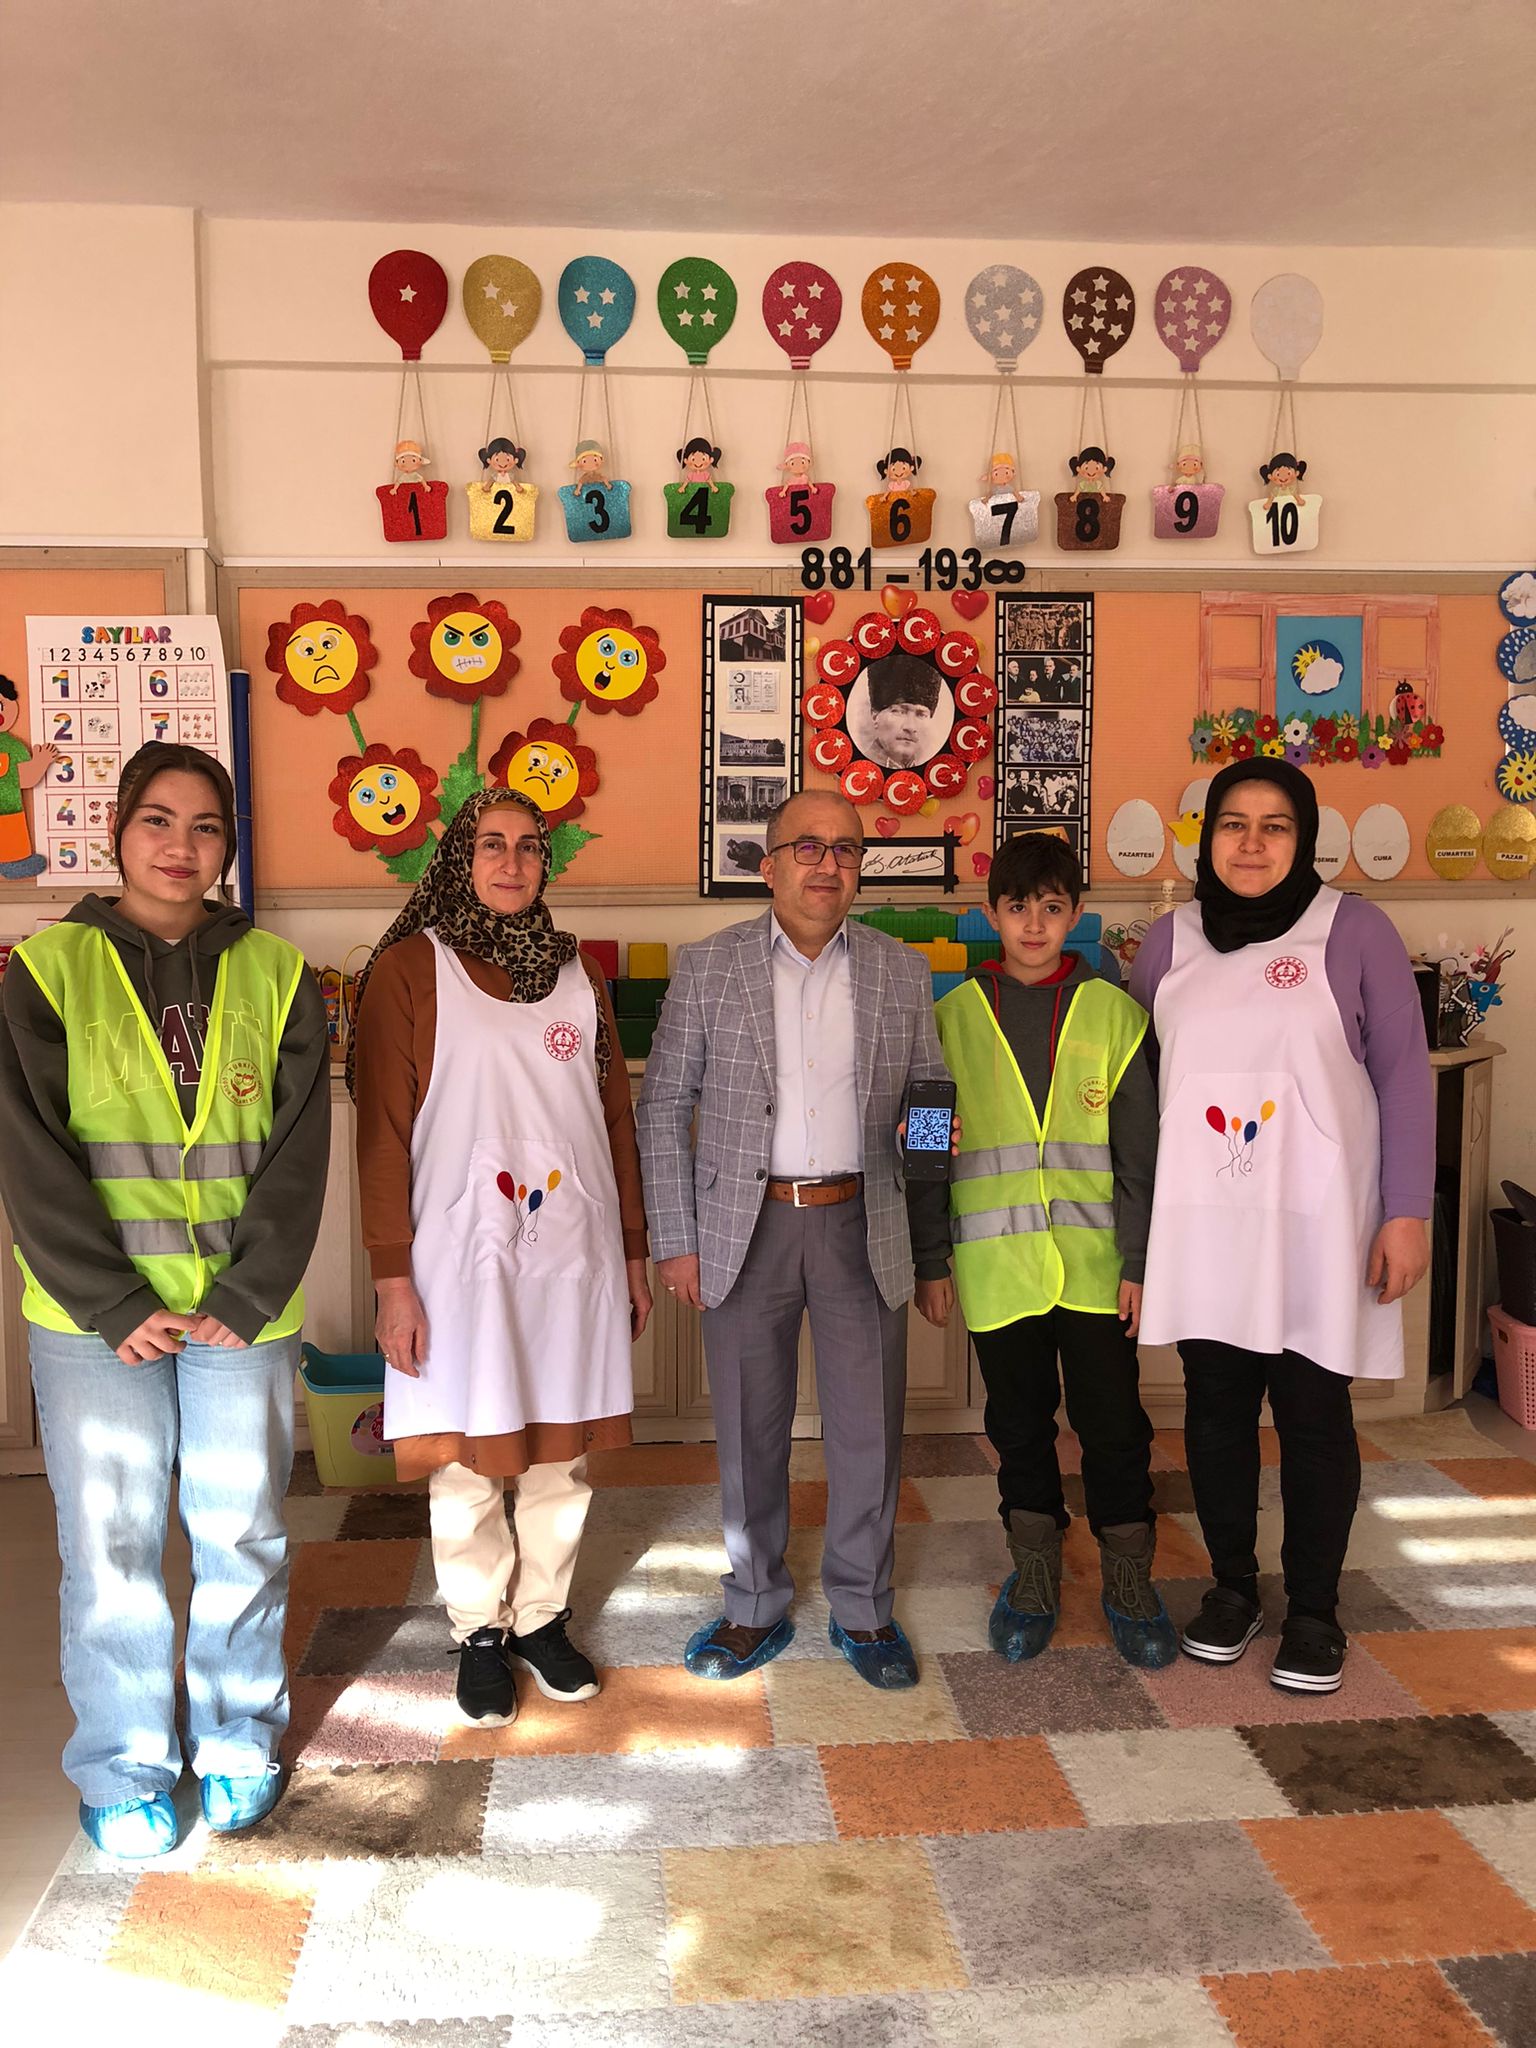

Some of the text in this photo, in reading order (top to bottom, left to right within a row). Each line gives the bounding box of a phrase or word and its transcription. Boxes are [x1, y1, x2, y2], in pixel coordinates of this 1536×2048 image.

[407, 490, 423, 537] 1
[492, 489, 515, 535] 2
[584, 489, 612, 534] 3
[679, 487, 713, 535] 4
[789, 489, 813, 536] 5
[889, 498, 912, 543] 6
[990, 501, 1019, 547] 7
[1074, 497, 1102, 544] 8
[1173, 490, 1200, 534] 9
[1266, 501, 1300, 547] 10
[50, 647, 205, 661] 1 2 3 4 5 6 7 8 9 10
[81, 626, 172, 644] SAYILAR
[52, 670, 69, 698] 1
[149, 670, 168, 697] 6
[53, 712, 73, 740] 2
[151, 713, 169, 740] 7
[55, 755, 75, 783] 3
[57, 799, 76, 826] 4
[59, 841, 77, 868] 5
